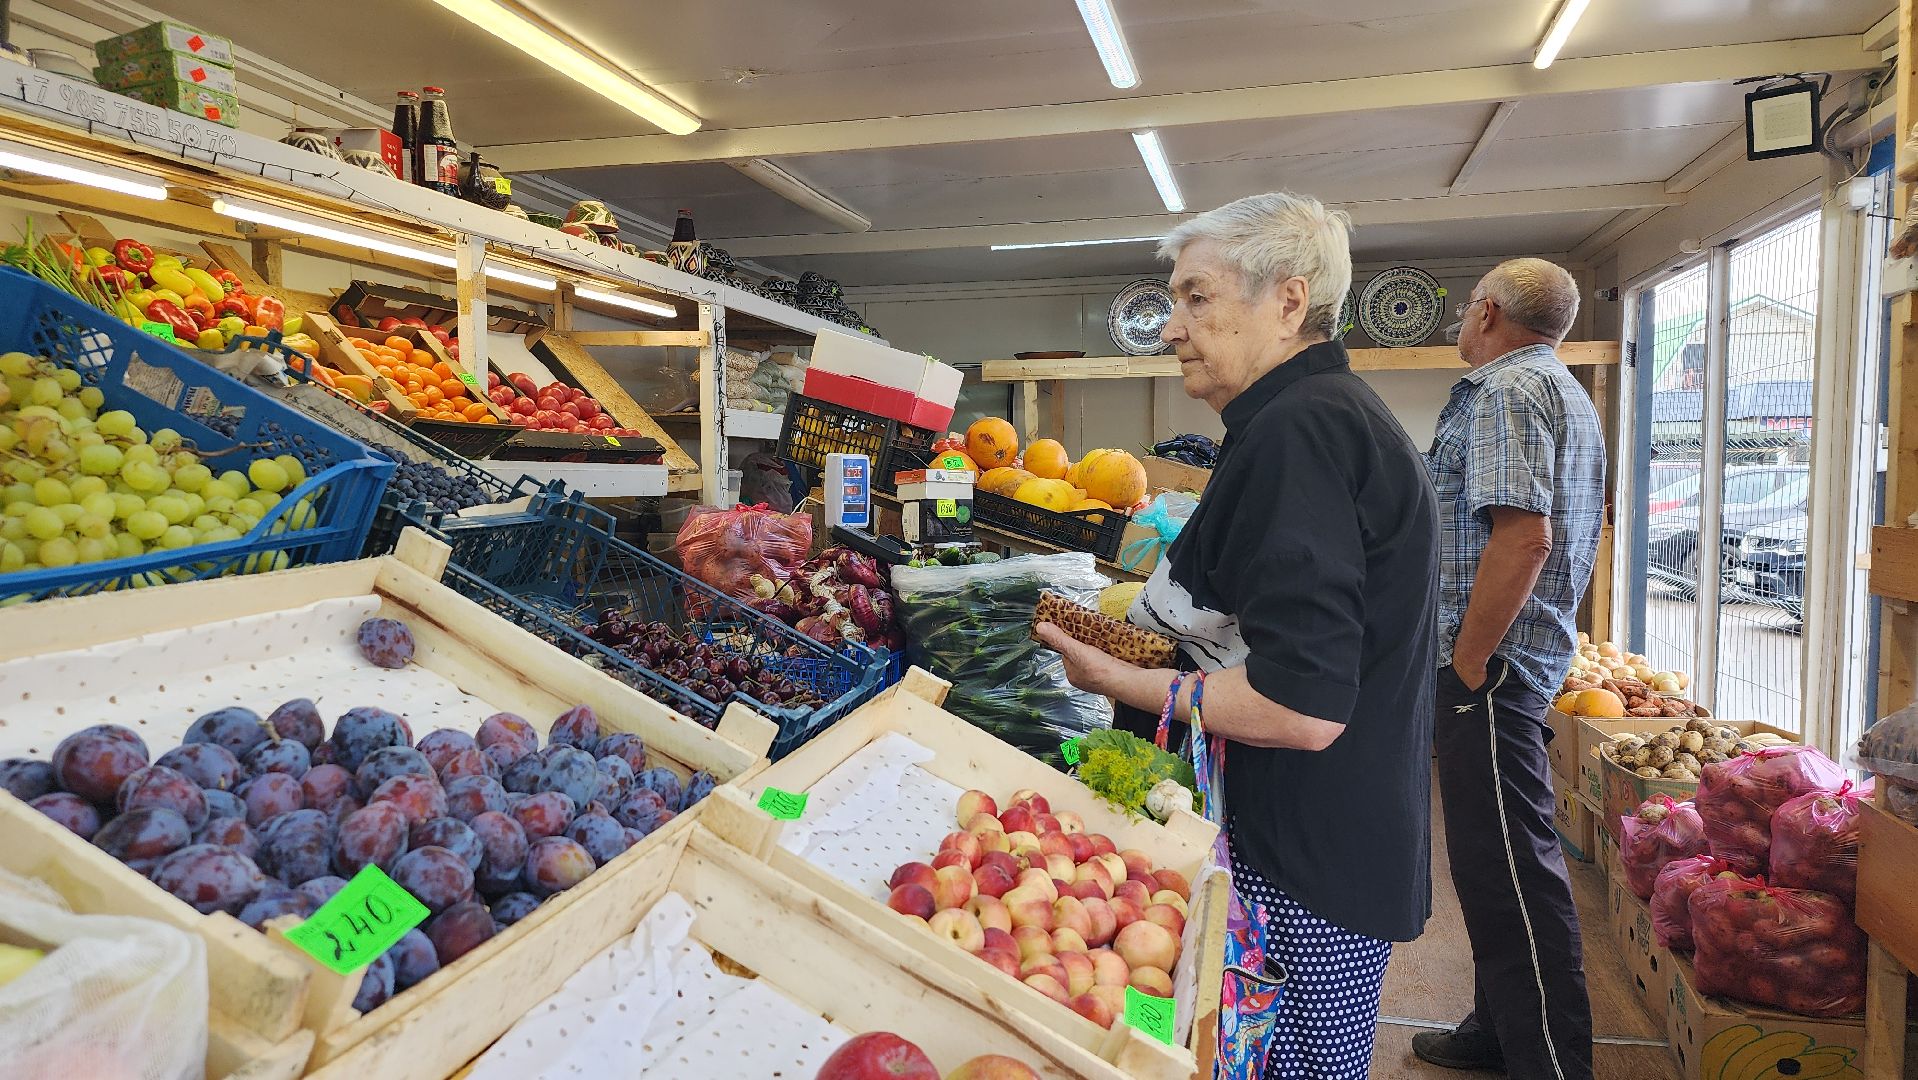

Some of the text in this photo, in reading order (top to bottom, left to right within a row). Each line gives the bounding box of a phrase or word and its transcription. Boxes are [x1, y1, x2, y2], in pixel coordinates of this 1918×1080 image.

[59, 83, 107, 124] 985
[113, 100, 161, 137] 755
[168, 118, 201, 148] 50
[206, 129, 237, 160] 70
